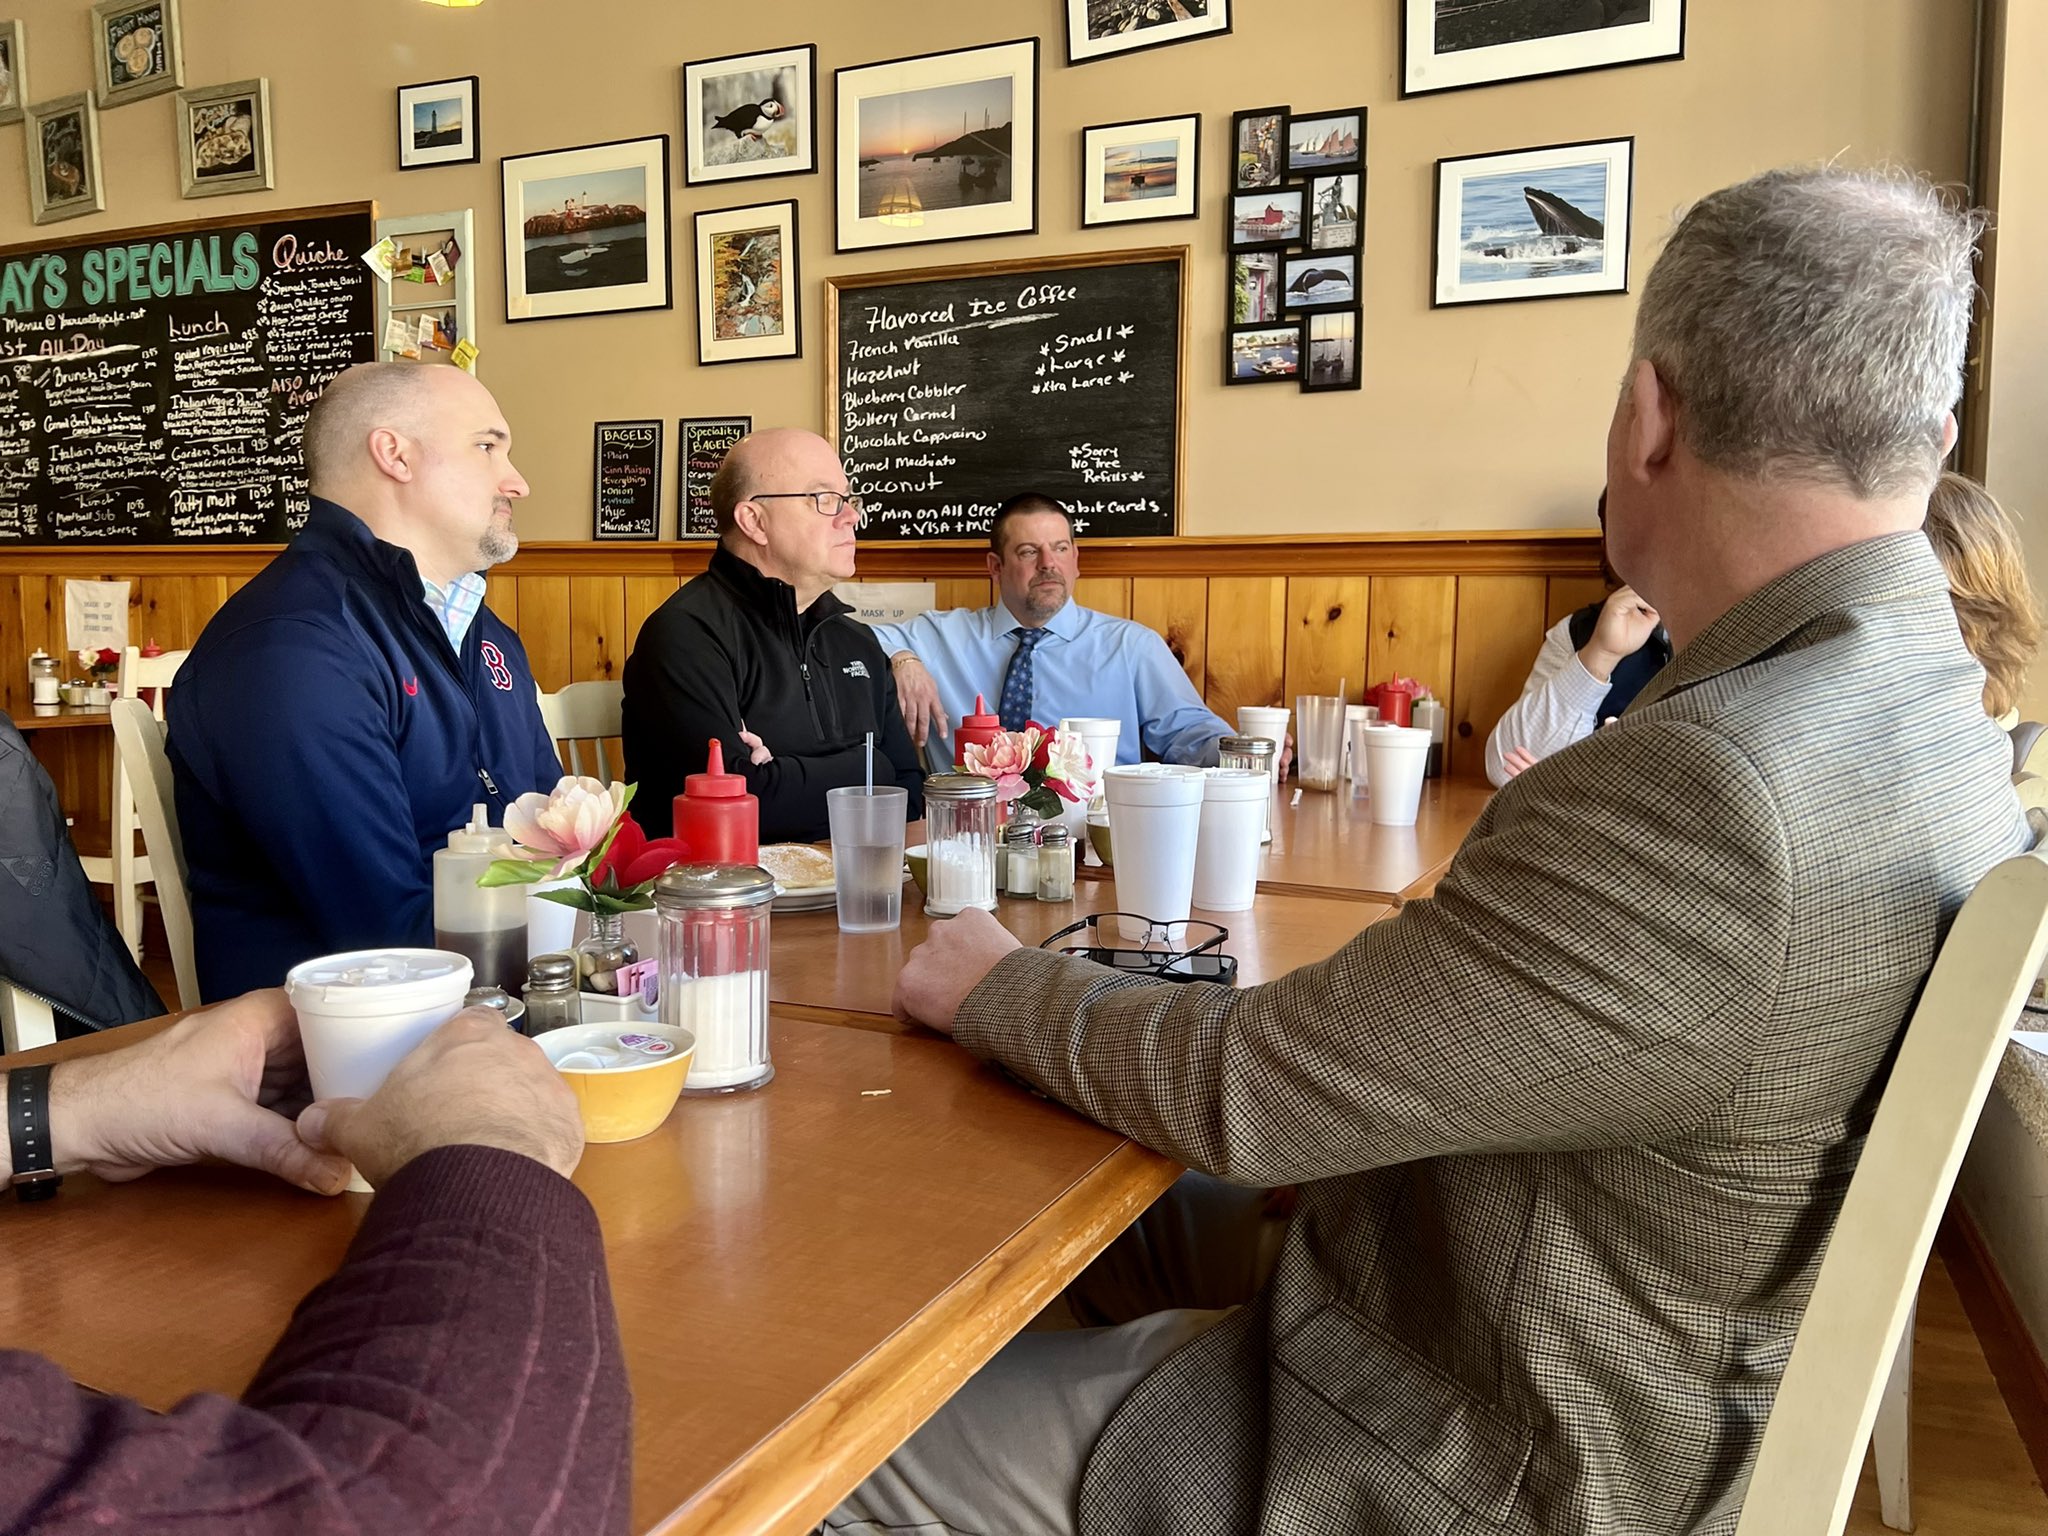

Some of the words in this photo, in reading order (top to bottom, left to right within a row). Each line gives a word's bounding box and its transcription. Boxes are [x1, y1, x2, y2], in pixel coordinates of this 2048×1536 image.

[272, 234, 349, 272] Quiche
[82, 231, 260, 306] SPECIALS
[864, 302, 955, 333] Flavored
[968, 298, 1007, 318] Ice
[1017, 284, 1078, 309] Coffee
[2, 317, 45, 333] Menu
[45, 314, 56, 330] @
[168, 311, 230, 338] Lunch
[847, 340, 898, 361] French
[903, 332, 960, 351] Vanilla
[1054, 326, 1112, 354] Small
[846, 357, 921, 388] Hazelnut
[1050, 354, 1106, 373] Large
[53, 366, 98, 388] Brunch
[98, 361, 139, 378] Burger
[1072, 375, 1113, 390] Large
[170, 394, 207, 410] Italian
[842, 389, 905, 412] Blueberry
[907, 382, 968, 401] Cobbler
[844, 411, 898, 433] Buttery
[903, 404, 956, 422] Carmel
[603, 429, 653, 442] BAGELS
[688, 425, 741, 442] Speciality
[843, 431, 911, 454] Chocolate
[48, 445, 94, 461] Italian
[95, 436, 147, 455] Breakfast
[171, 446, 211, 461] Garden
[212, 441, 245, 457] Salad
[607, 451, 630, 460] Plain
[692, 439, 735, 453] BAGELS
[623, 464, 652, 475] Raisin
[843, 457, 889, 476] Carmel
[1071, 458, 1089, 470] No
[1090, 456, 1121, 469] Free
[604, 476, 647, 488] Everything
[606, 486, 634, 495] Onion
[850, 471, 943, 496] Coconut
[169, 489, 203, 515] Patty
[206, 491, 237, 508] Melt
[94, 508, 116, 522] Sub
[605, 504, 627, 523] Rye
[881, 508, 913, 523] Min
[916, 508, 939, 520] on
[941, 504, 963, 517] All
[604, 520, 634, 533] Harvest
[913, 521, 950, 535] VISA
[860, 608, 885, 618] MASK
[892, 609, 905, 618] UP
[480, 640, 513, 691] B
